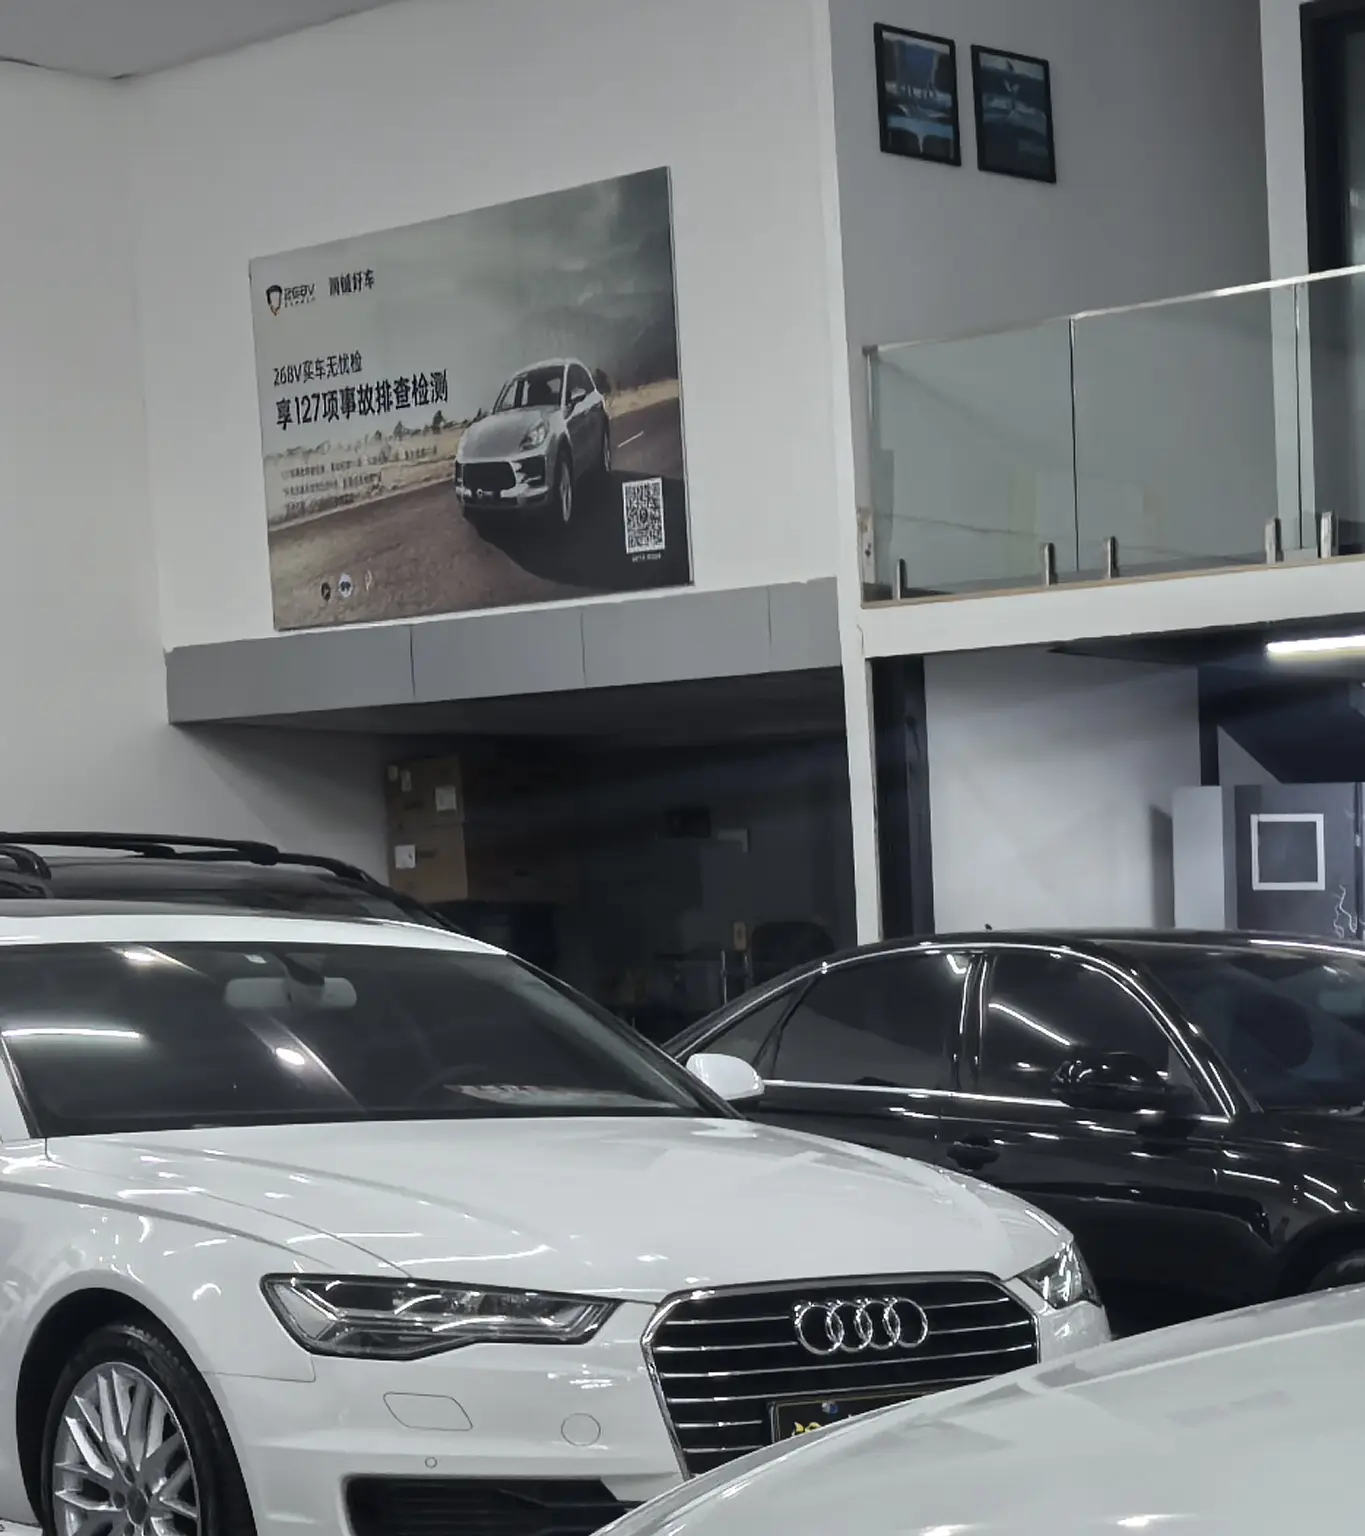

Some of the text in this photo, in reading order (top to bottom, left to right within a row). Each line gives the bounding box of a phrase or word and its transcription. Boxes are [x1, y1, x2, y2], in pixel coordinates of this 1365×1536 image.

[276, 368, 449, 431] 享127项事故排查检测
